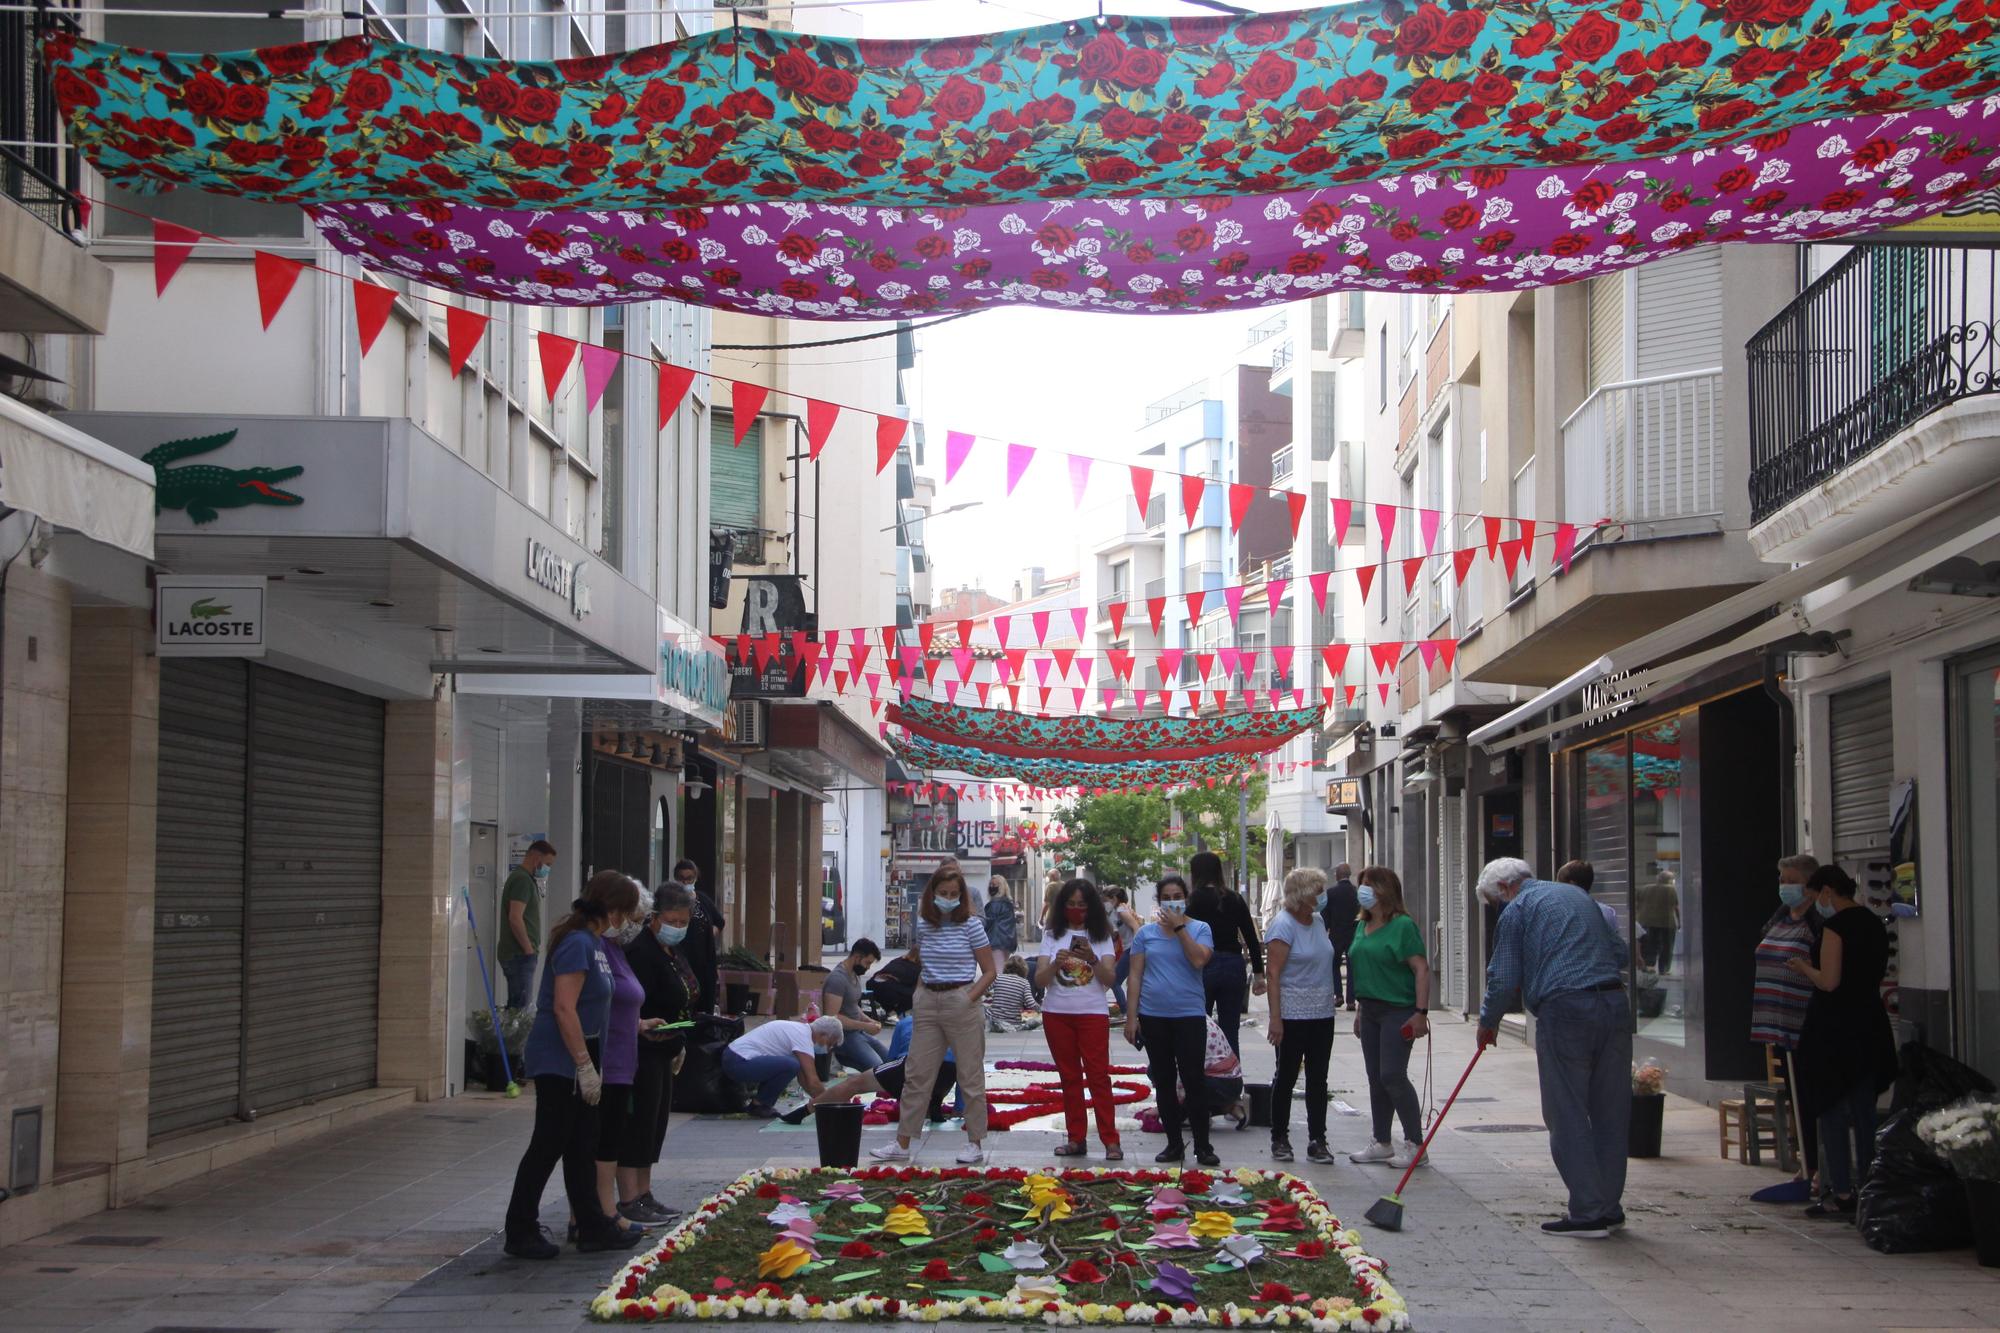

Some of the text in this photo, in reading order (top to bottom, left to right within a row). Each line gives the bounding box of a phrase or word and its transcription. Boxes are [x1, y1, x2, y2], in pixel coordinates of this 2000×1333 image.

[747, 580, 779, 638] R
[169, 622, 254, 636] LACOSTE
[956, 820, 1000, 848] BLUE
